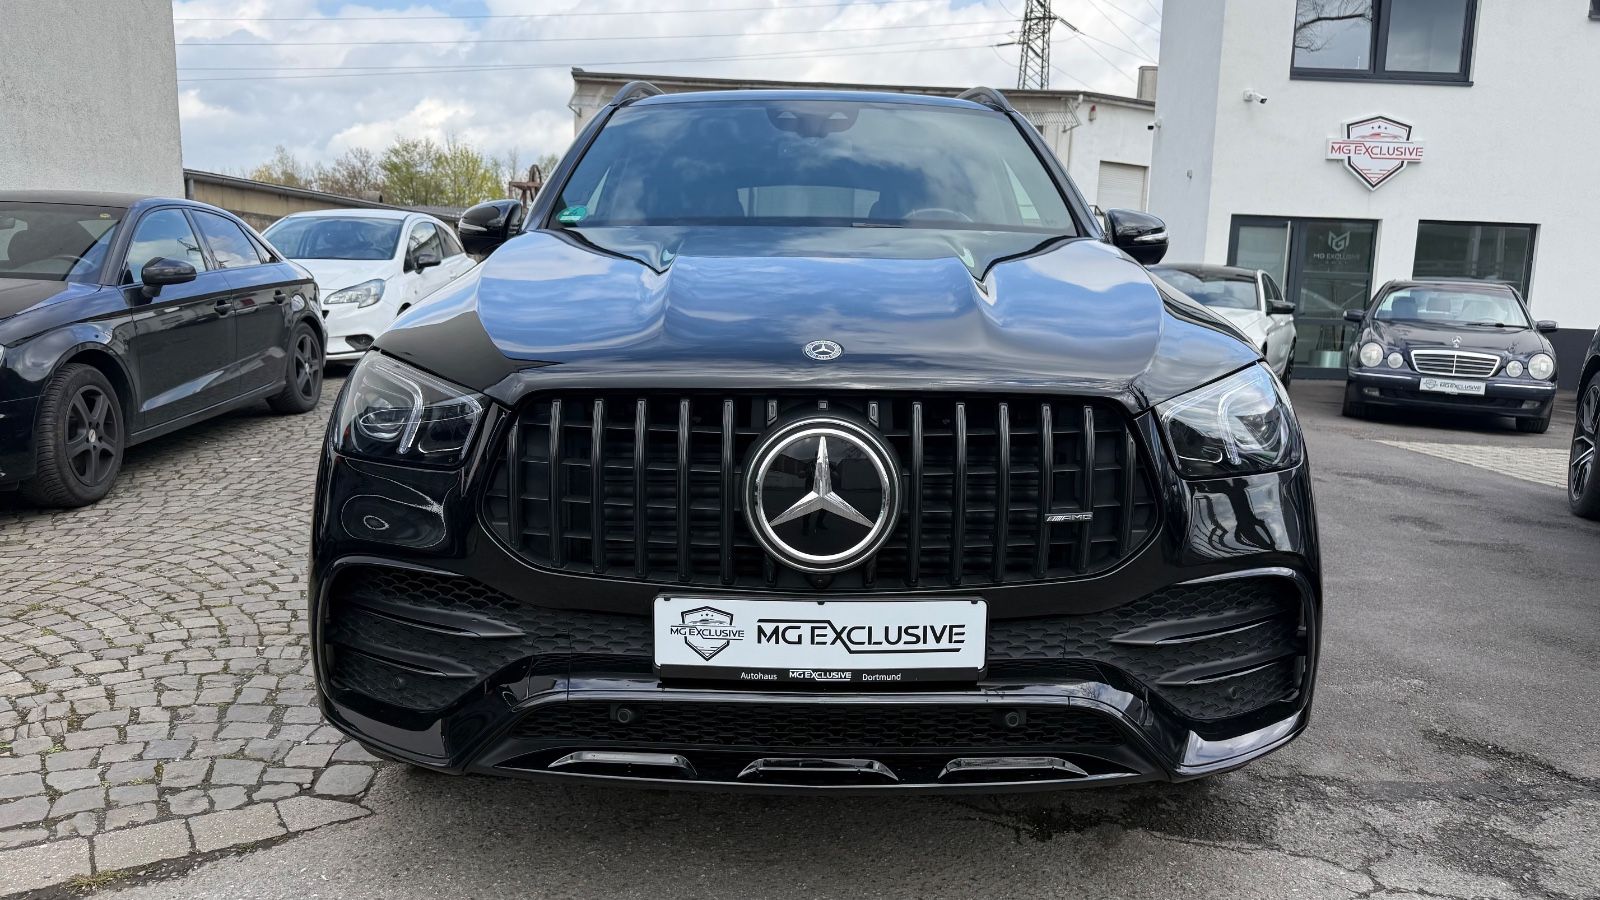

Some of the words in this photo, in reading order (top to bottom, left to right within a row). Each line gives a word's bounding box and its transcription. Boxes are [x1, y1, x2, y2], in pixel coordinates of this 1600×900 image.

[1330, 145, 1351, 155] MG
[1354, 144, 1424, 157] EXCLUSIVE
[670, 627, 686, 636] MG
[688, 628, 744, 638] EXCLUSIVE
[757, 625, 802, 645] MG
[811, 624, 966, 647] EXCLUSIVE
[741, 672, 777, 680] Autohaus
[789, 671, 804, 679] MG
[804, 671, 852, 679] EXCLUSIVE
[862, 673, 901, 681] Dortmund
